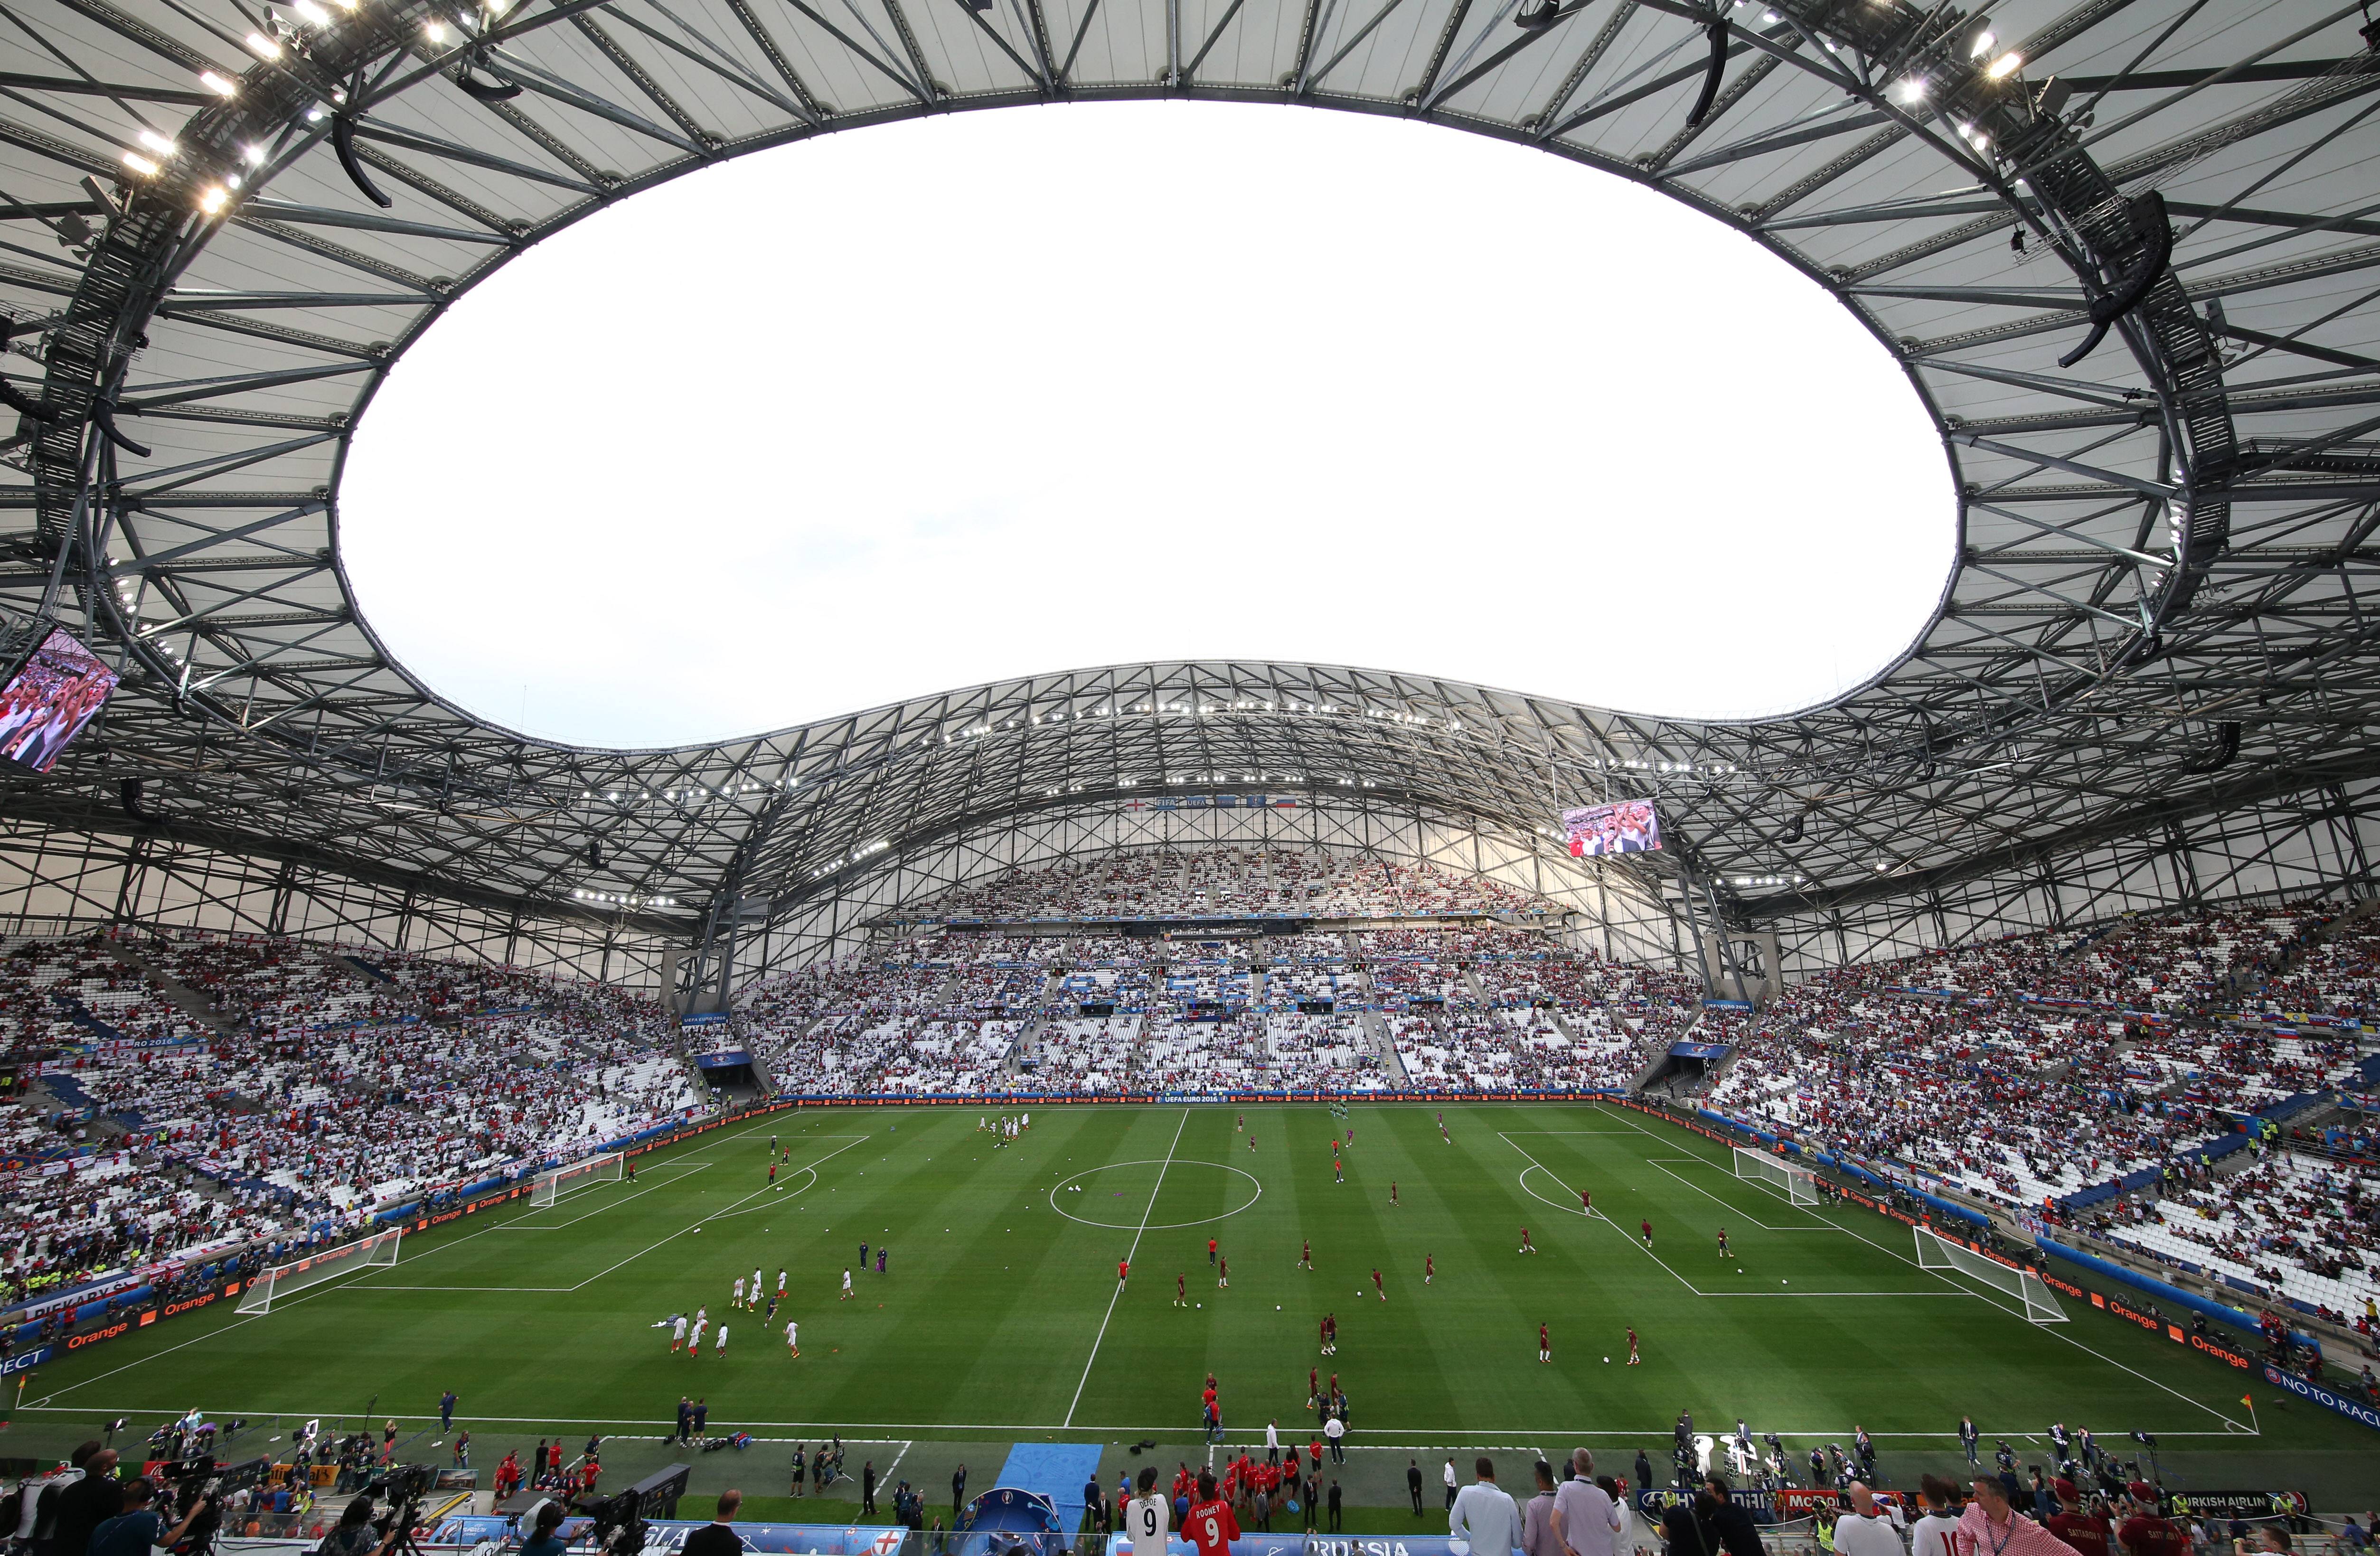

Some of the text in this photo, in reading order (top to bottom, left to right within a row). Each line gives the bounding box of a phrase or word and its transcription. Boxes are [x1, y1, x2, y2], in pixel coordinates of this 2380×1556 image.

[134, 1038, 173, 1048] RO 2016
[776, 1101, 793, 1109] Orange
[1607, 1095, 1620, 1104] Orange
[752, 1107, 767, 1115] Orange
[1628, 1101, 1642, 1111] Orange
[727, 1114, 743, 1123] Orange
[1649, 1108, 1663, 1118] Orange
[704, 1122, 719, 1130] Orange
[1670, 1115, 1684, 1126] Orange
[680, 1129, 696, 1139] Orange
[1691, 1124, 1704, 1134] Orange
[655, 1138, 671, 1148] Orange
[1711, 1132, 1725, 1143] Orange
[626, 1146, 644, 1157] Orange
[560, 1168, 582, 1180] Orange
[522, 1181, 546, 1193] Orange
[480, 1194, 507, 1208] Orange
[1851, 1191, 1874, 1208] Orange
[432, 1210, 461, 1224] Orange
[1890, 1209, 1916, 1226] Orange
[1934, 1227, 1964, 1246] Orange
[317, 1246, 355, 1264] Orange
[1984, 1247, 2019, 1269] Orange
[2042, 1273, 2082, 1297] Orange
[165, 1293, 215, 1315] Orange
[2110, 1301, 2158, 1330] Orange
[68, 1322, 128, 1349] Orange
[2192, 1335, 2249, 1369] Orange
[2282, 1375, 2308, 1395] NO
[2310, 1387, 2334, 1406] TO
[1139, 1498, 1157, 1509] DEFOE
[2228, 1497, 2267, 1507] AIRLIN
[1196, 1504, 1220, 1519] ROONEY
[1143, 1508, 1157, 1537] 9
[1205, 1518, 1219, 1547] 9
[2067, 1528, 2097, 1540] SATTAROV
